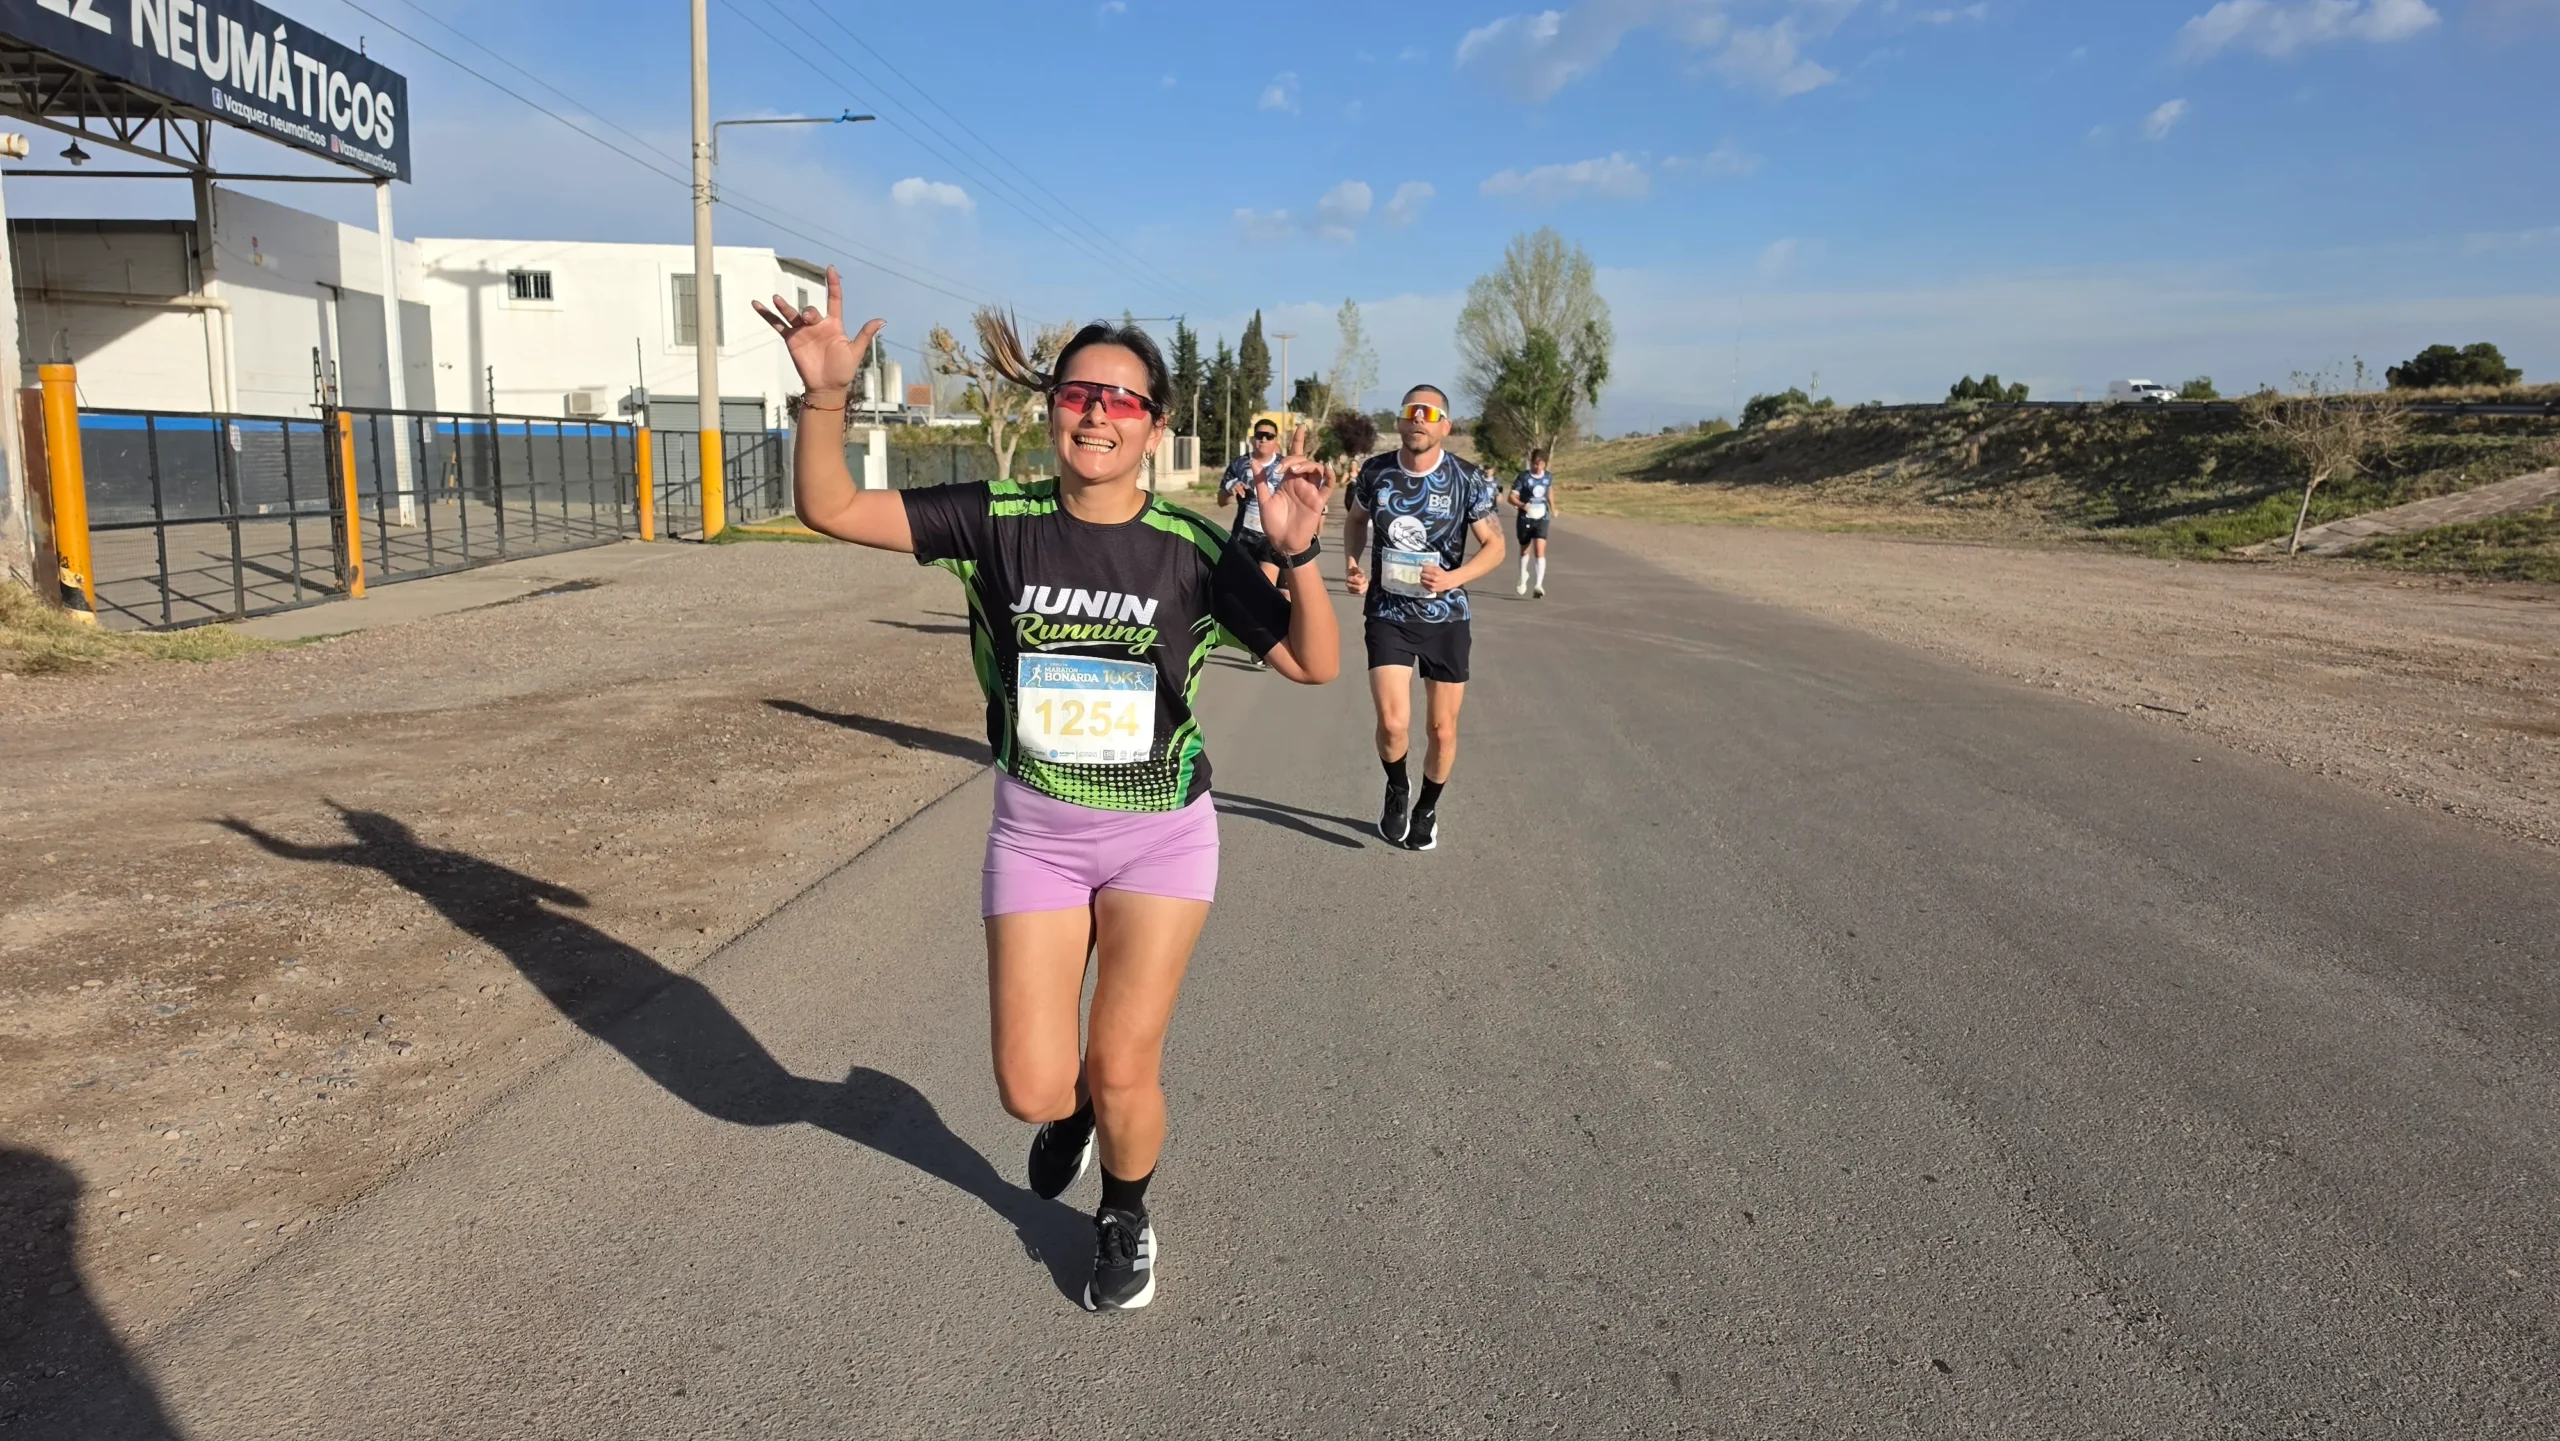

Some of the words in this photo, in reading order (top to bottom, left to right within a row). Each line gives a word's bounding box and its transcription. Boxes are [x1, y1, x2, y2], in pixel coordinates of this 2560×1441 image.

[131, 0, 394, 149] NEUMÁTICOS
[223, 93, 269, 126] Vazquez
[269, 114, 327, 148] neumaticos
[338, 139, 397, 173] Vazneumaticos
[1009, 585, 1159, 625] JUNIN
[1011, 613, 1160, 656] Running
[1044, 673, 1099, 682] BONARDA
[1035, 699, 1140, 736] 1254
